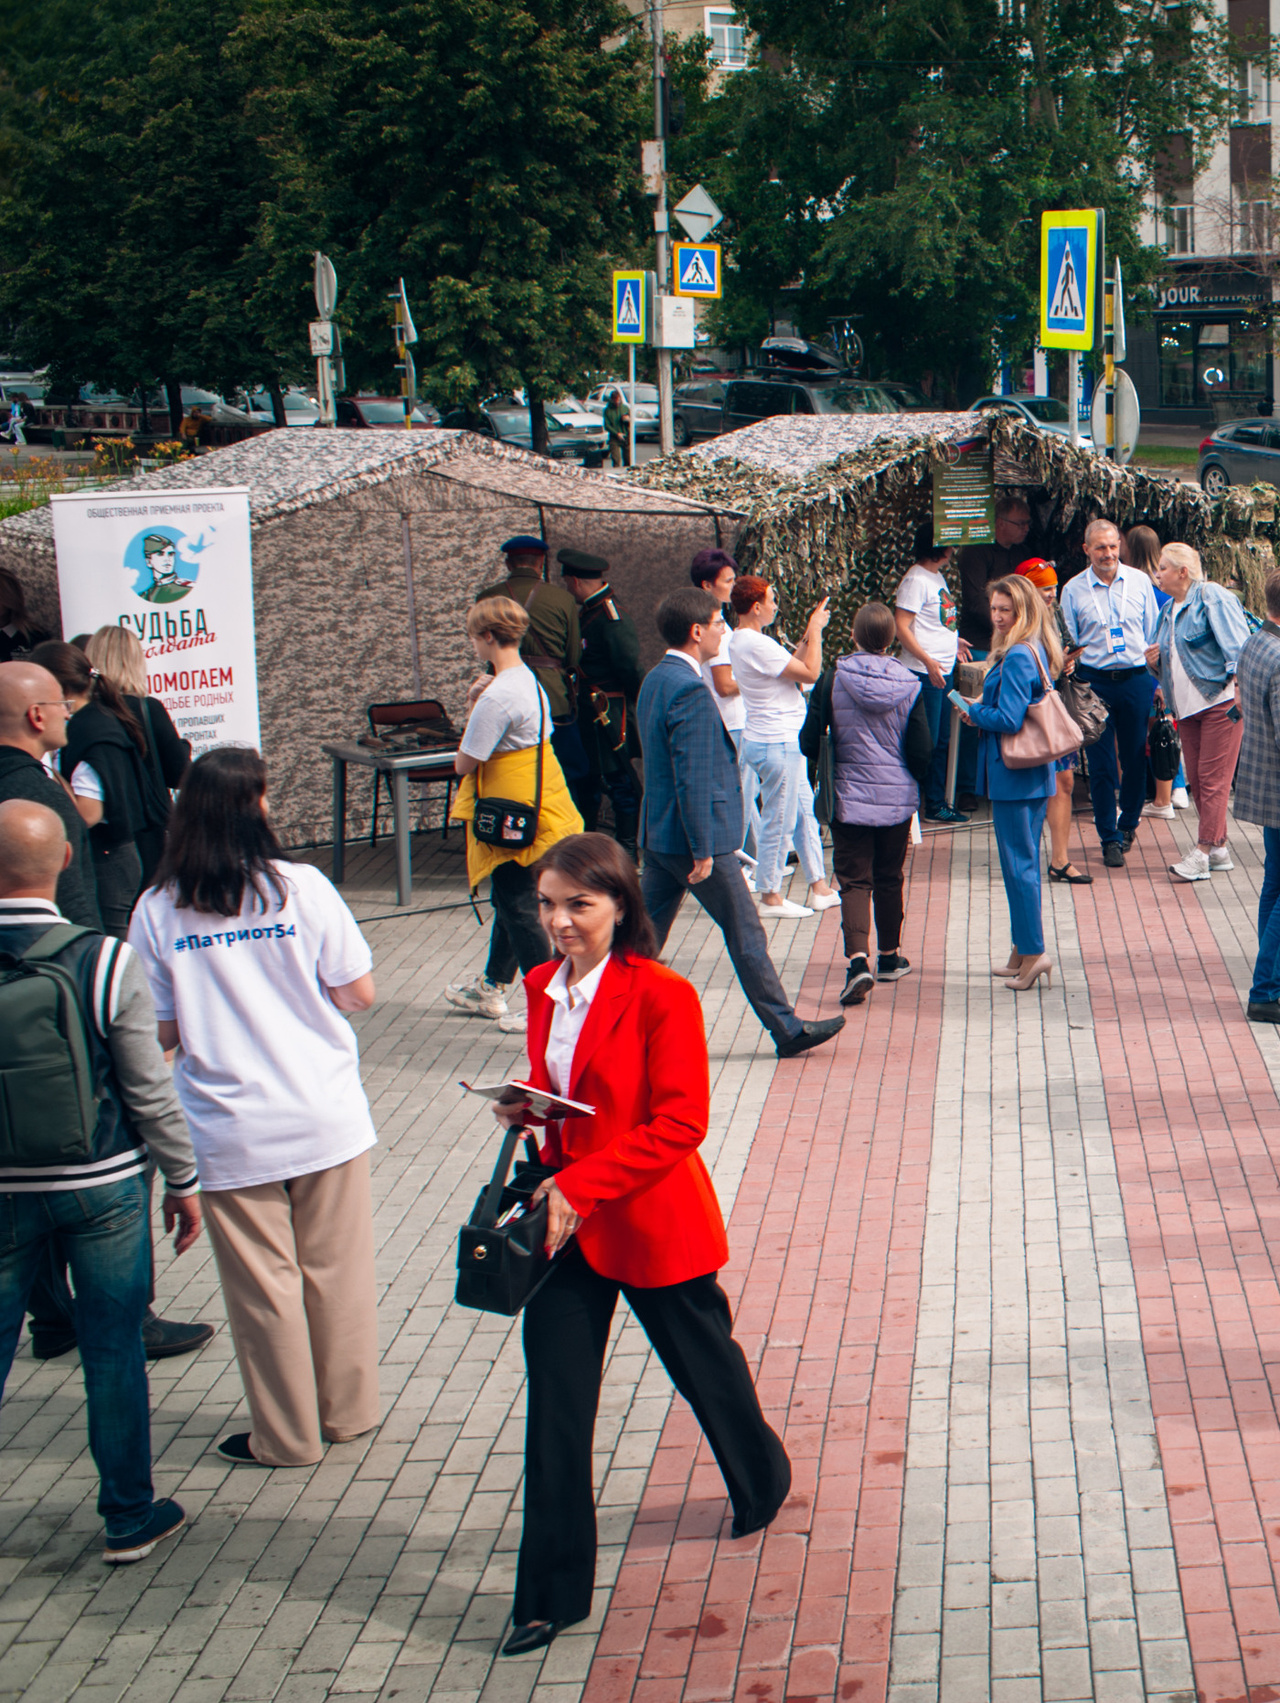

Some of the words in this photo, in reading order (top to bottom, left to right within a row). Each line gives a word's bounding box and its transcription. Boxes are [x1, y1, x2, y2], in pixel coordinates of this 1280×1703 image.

[87, 505, 149, 519] ОБЩЕСТВЕННАЯ
[150, 503, 191, 516] ПРИЕМНАЯ
[193, 502, 225, 513] ПРОЕКТА
[145, 631, 218, 659] олдата
[194, 691, 234, 708] РОДНЫХ
[177, 714, 225, 728] ПРОПАВШИХ
[174, 923, 296, 953] #Патриот54
